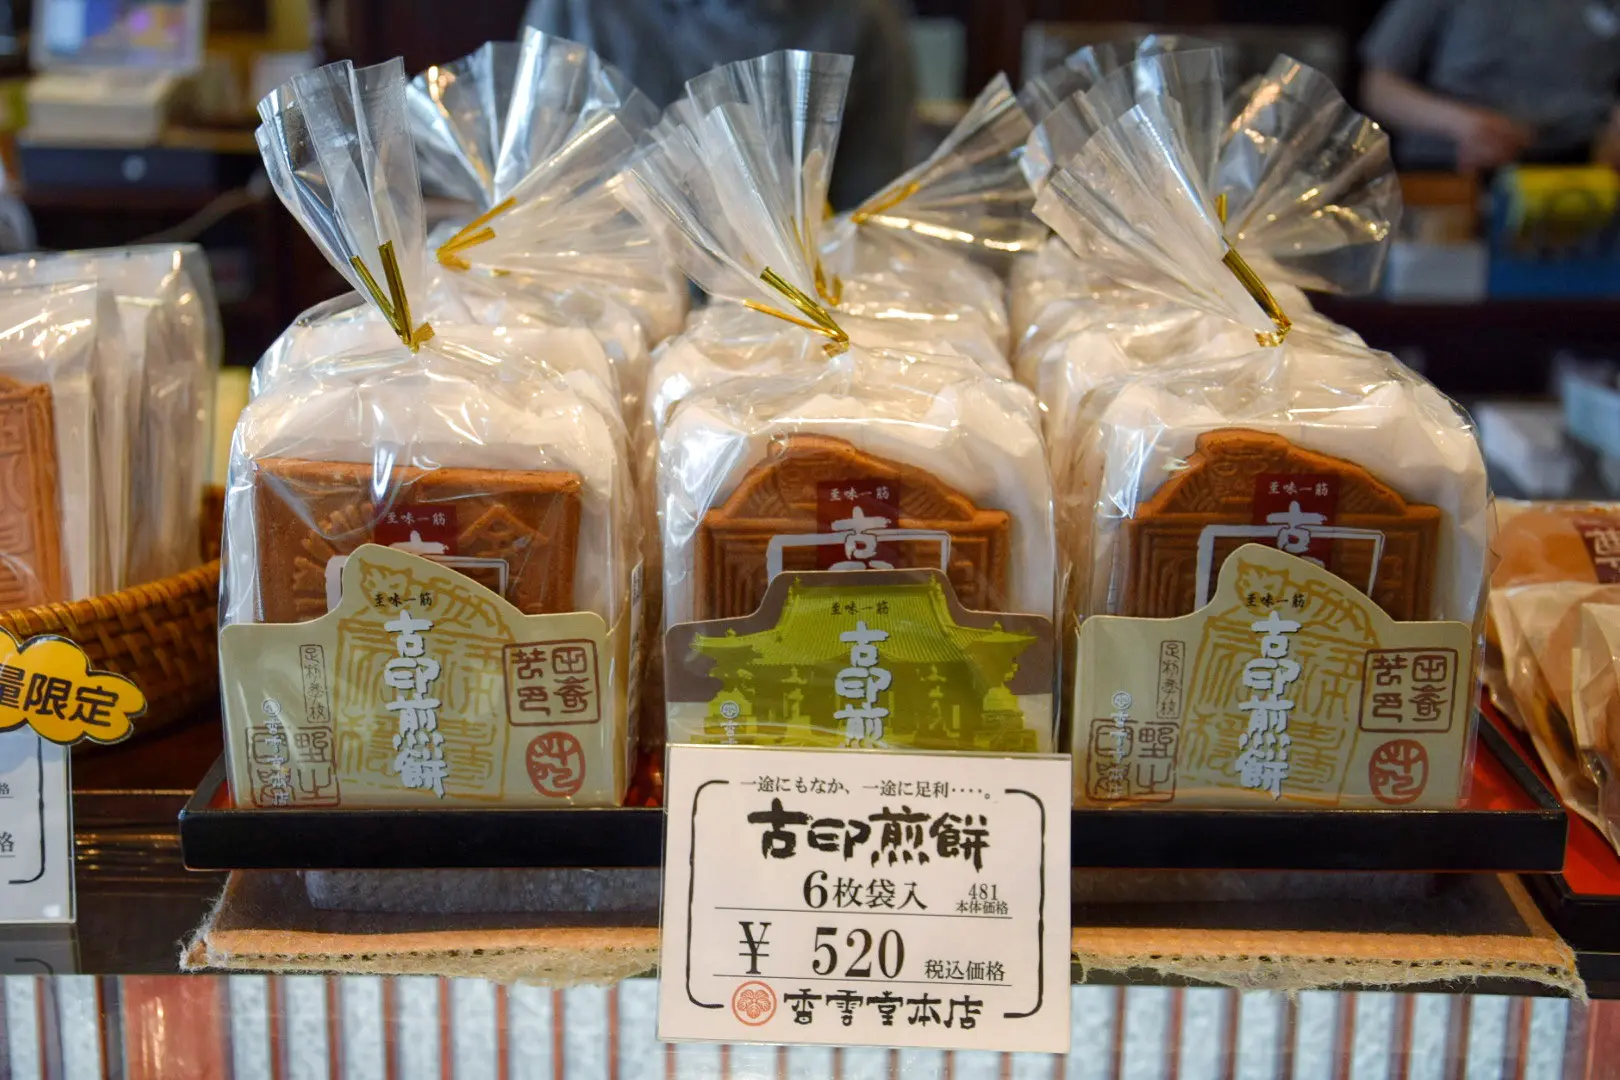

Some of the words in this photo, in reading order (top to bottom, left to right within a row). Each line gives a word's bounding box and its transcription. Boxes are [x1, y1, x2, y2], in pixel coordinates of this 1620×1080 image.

[830, 486, 889, 501] 至味一筋
[1268, 481, 1328, 496] 至味一筋
[386, 512, 446, 526] 至味一筋
[1266, 500, 1328, 568] 古
[374, 592, 433, 607] 至味一筋
[831, 601, 889, 615] 至味一筋
[1246, 592, 1305, 608] 至味一筋
[384, 609, 450, 799] 古印煎餅
[1234, 610, 1303, 802] 古印煎餅
[747, 797, 991, 873] 古印煎餅
[803, 870, 928, 911] 6枚袋入
[968, 883, 999, 901] 481
[955, 900, 1009, 915] 本体価格
[738, 921, 772, 975] ¥
[812, 926, 905, 979] 520
[924, 959, 1006, 982] 税込価格
